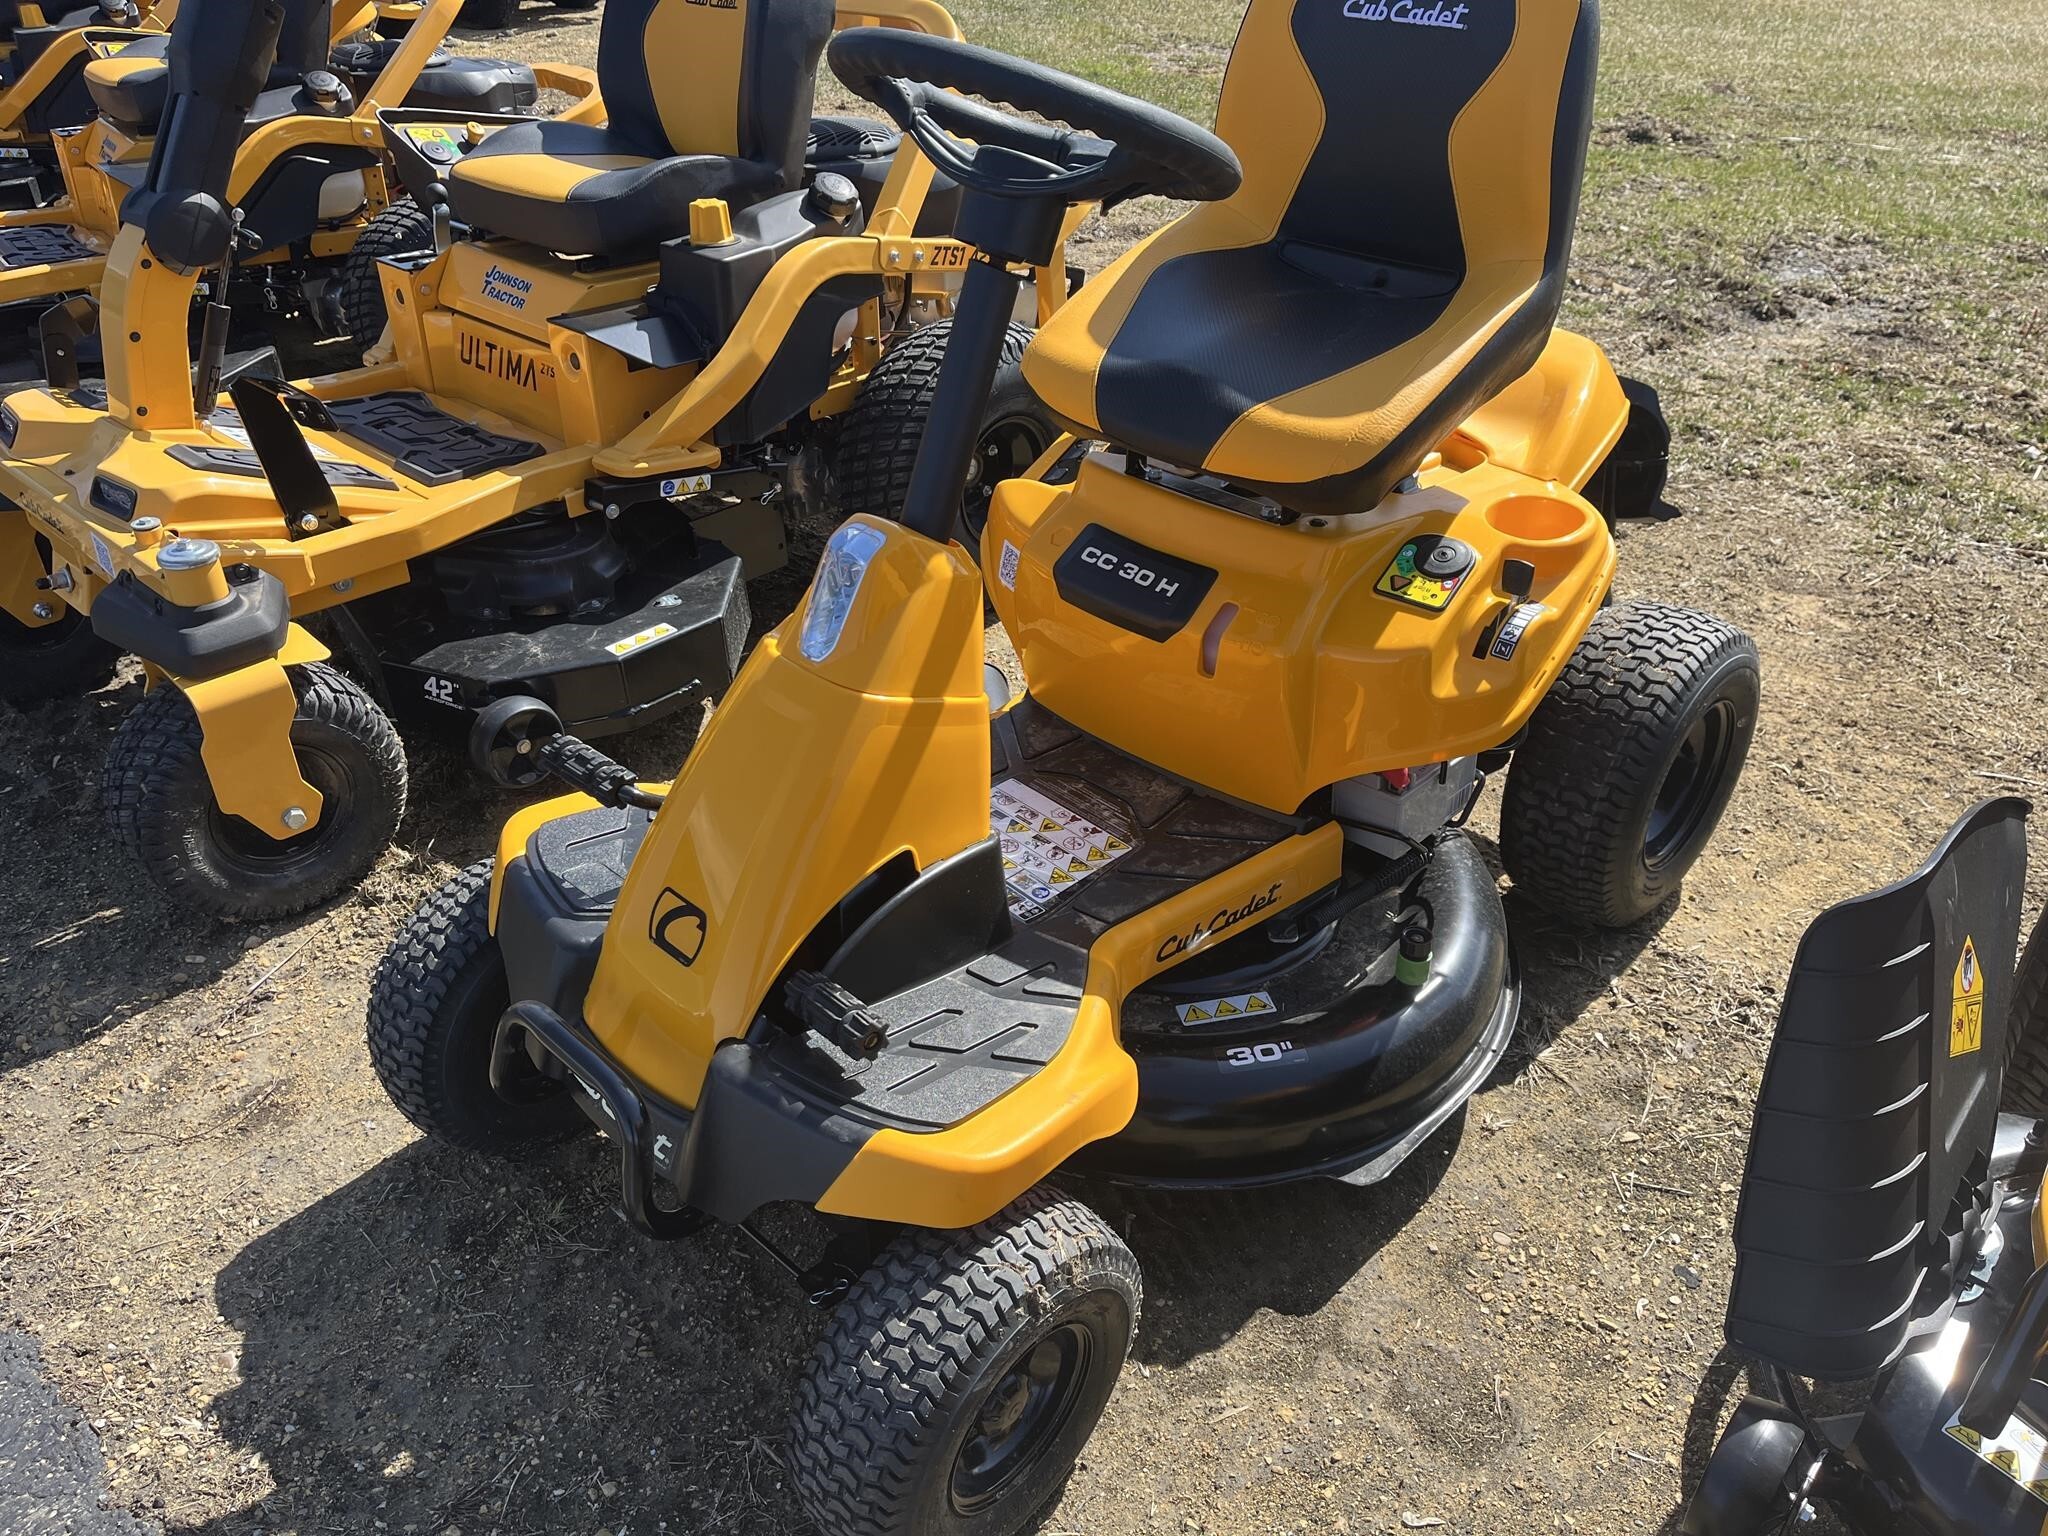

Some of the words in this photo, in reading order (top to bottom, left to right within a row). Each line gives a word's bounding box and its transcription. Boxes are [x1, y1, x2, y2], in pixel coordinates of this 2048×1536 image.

[1343, 0, 1389, 21] Cub
[1390, 0, 1470, 30] Cadet
[930, 246, 967, 266] ZTS1
[484, 264, 533, 293] JOHNSON
[480, 279, 527, 310] TRACTOR
[460, 331, 538, 393] ULTIMA
[1080, 546, 1119, 571] CC
[1118, 562, 1156, 588] 30
[1154, 577, 1180, 598] H
[423, 676, 460, 703] 42"
[1155, 922, 1204, 963] Cub
[1206, 881, 1283, 937] Cadet
[1226, 1040, 1294, 1067] 30"
